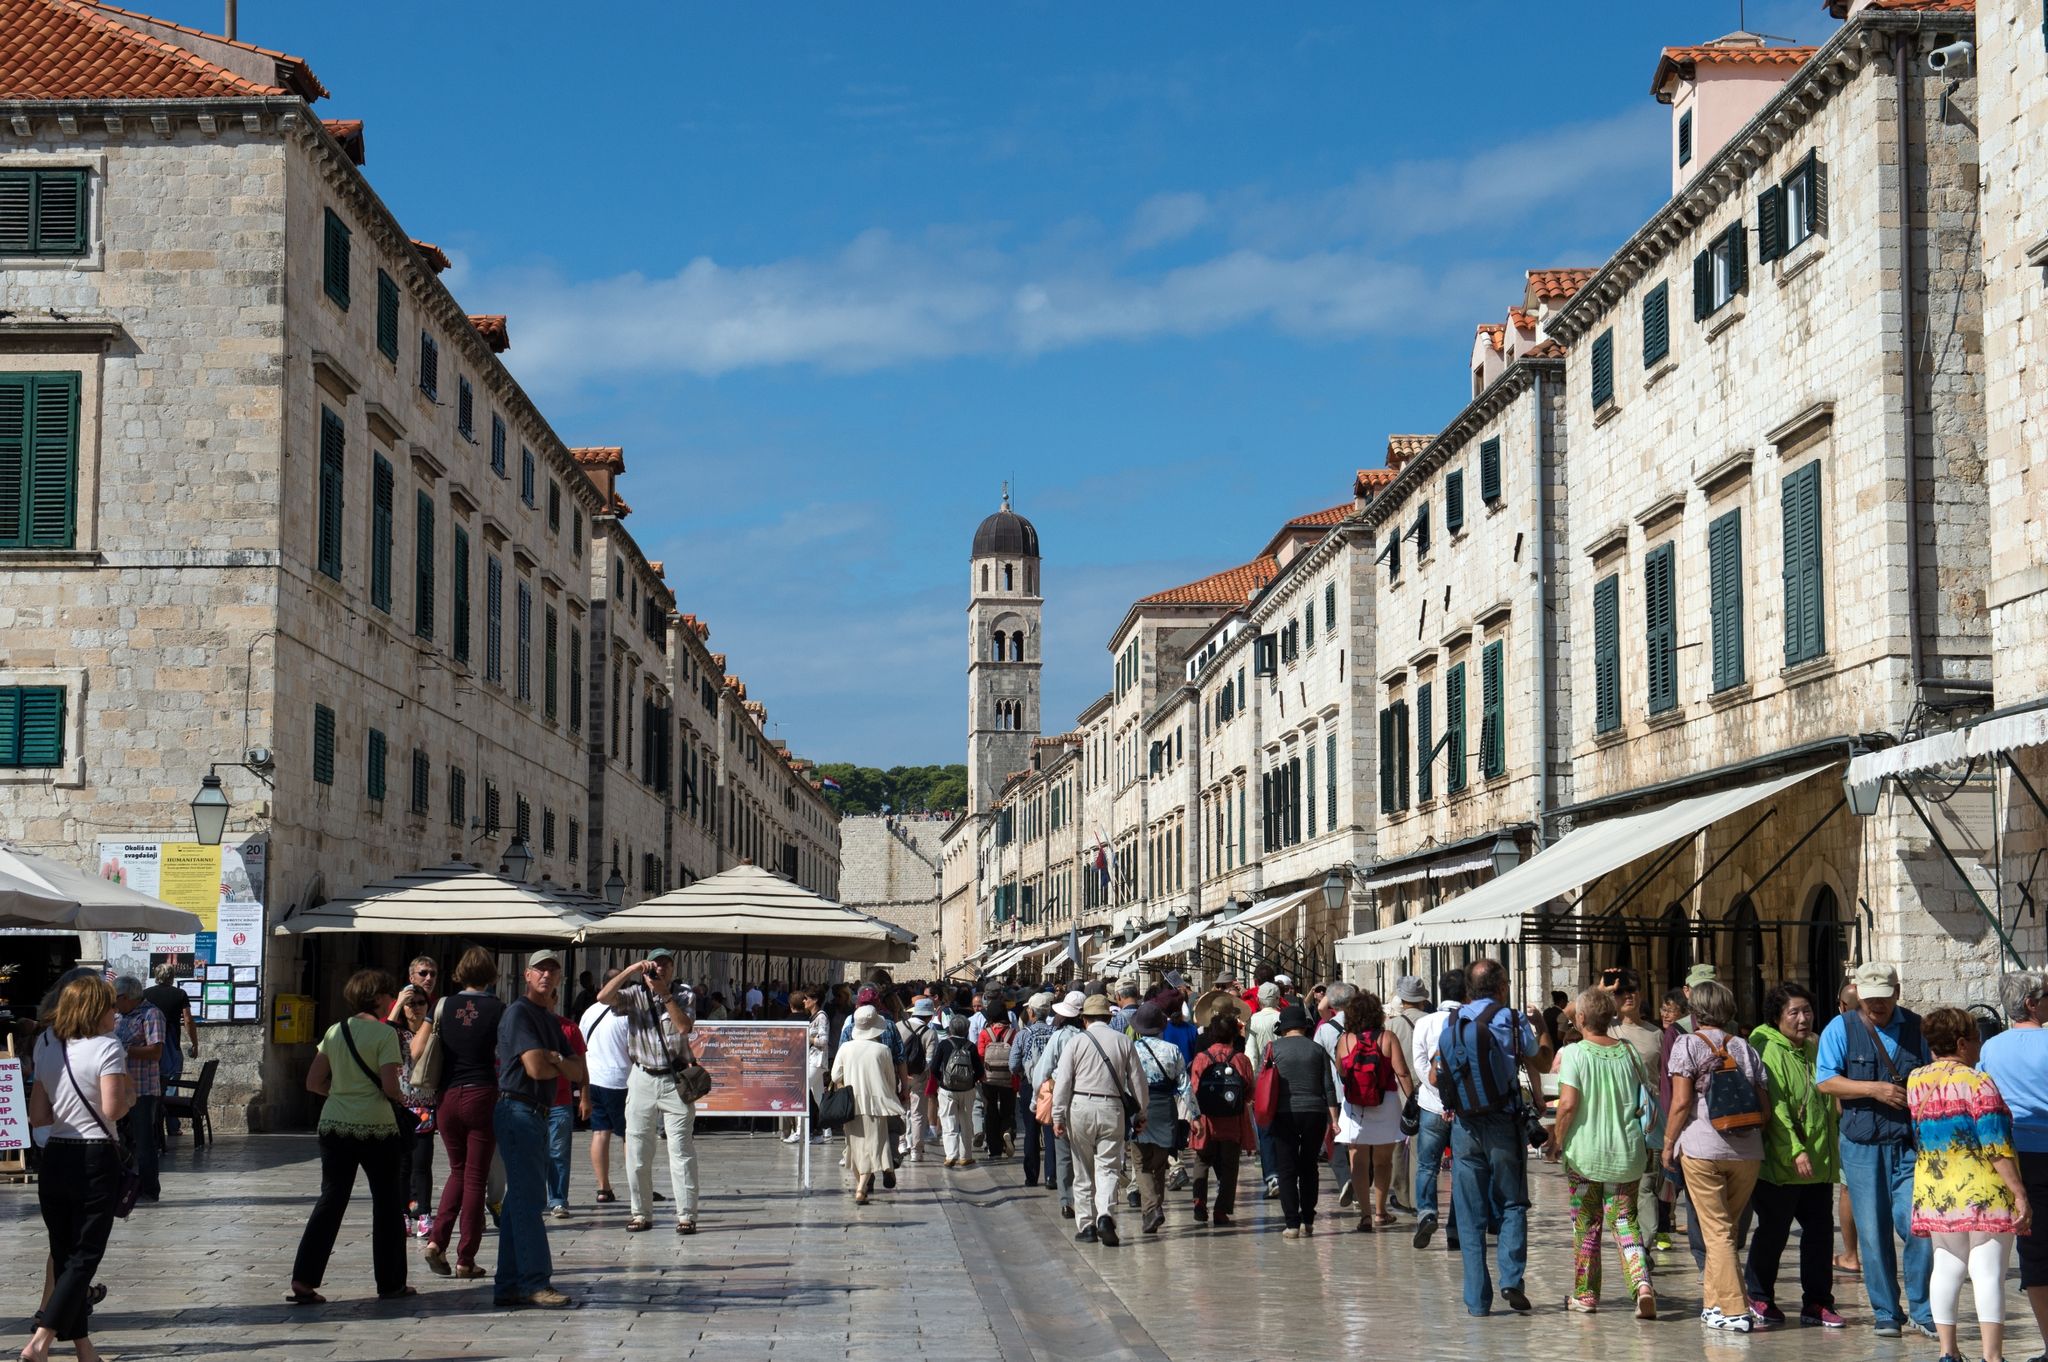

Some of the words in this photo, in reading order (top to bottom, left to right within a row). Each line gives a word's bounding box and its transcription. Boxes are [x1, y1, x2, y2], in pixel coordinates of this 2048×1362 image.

[245, 844, 261, 855] 20
[132, 931, 147, 942] 20
[155, 945, 191, 953] KONCERT
